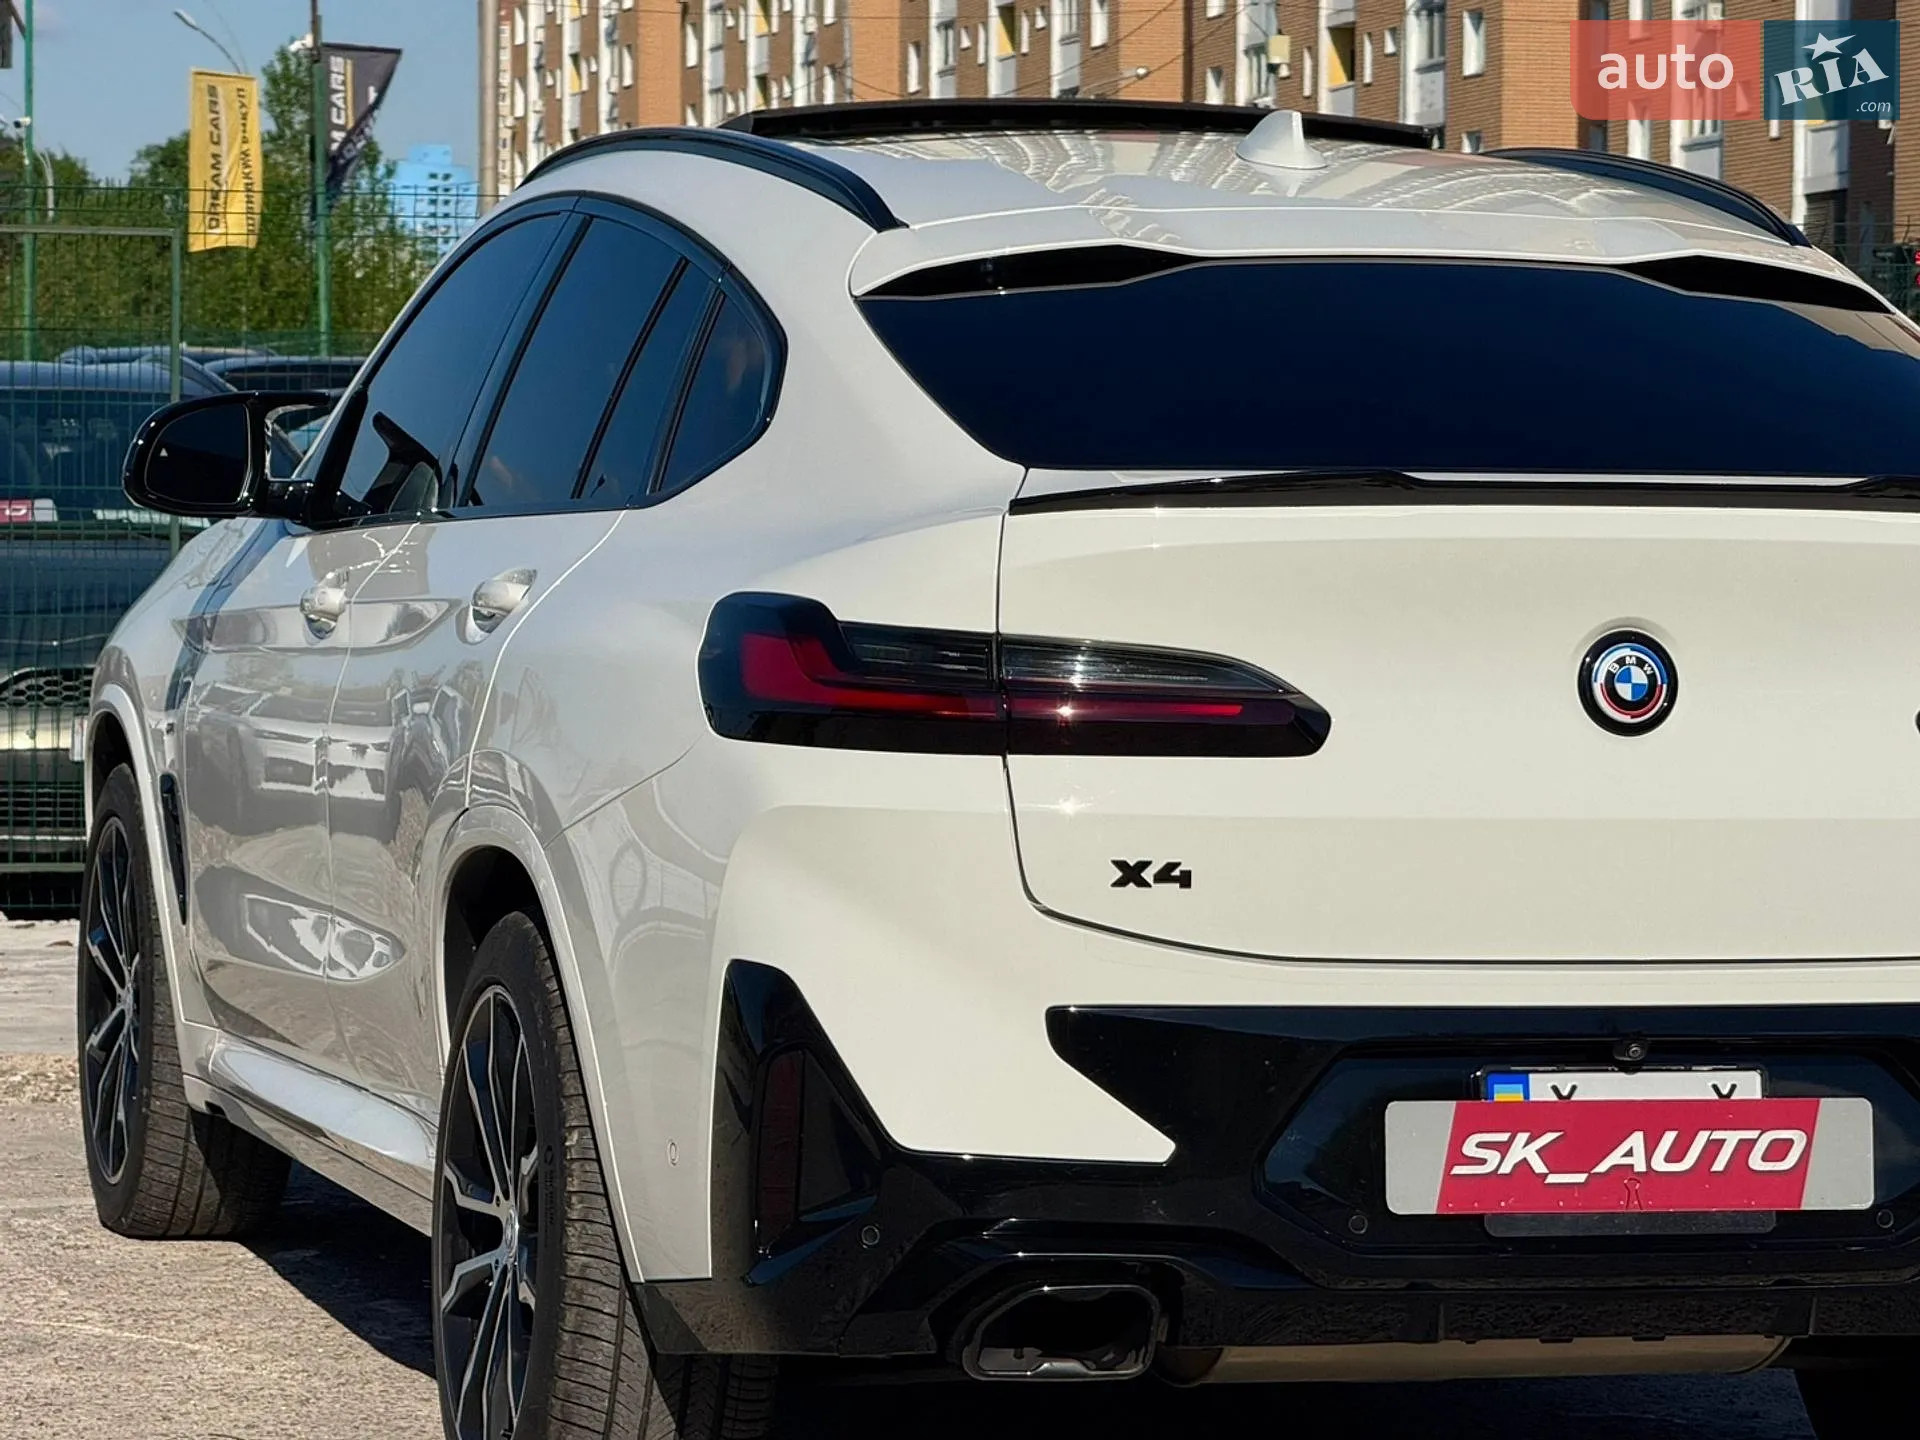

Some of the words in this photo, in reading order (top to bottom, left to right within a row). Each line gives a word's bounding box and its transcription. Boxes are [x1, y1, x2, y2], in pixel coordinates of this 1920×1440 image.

[207, 84, 221, 146] CARS
[329, 55, 346, 126] CARS
[207, 152, 222, 230] DREAM
[1608, 655, 1654, 675] BMW
[1109, 859, 1192, 889] X4
[1450, 1129, 1808, 1184] SK_AUTO
